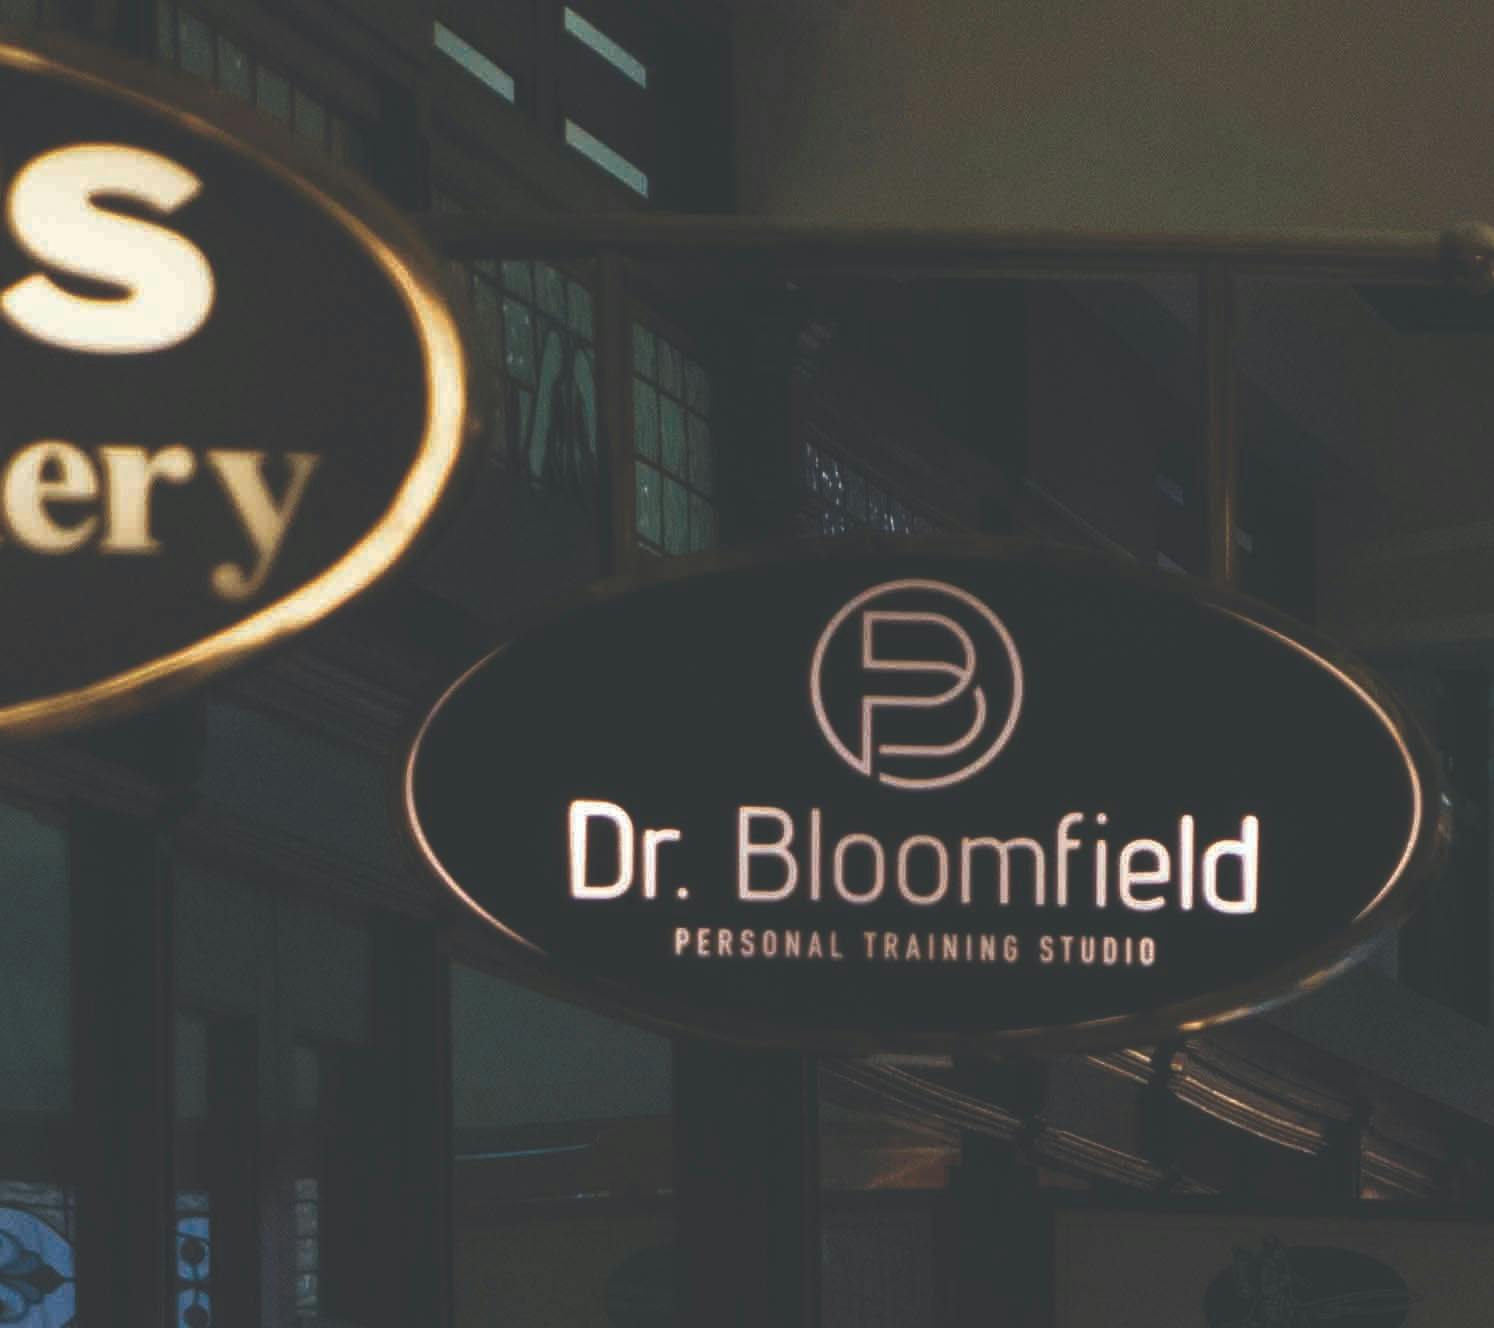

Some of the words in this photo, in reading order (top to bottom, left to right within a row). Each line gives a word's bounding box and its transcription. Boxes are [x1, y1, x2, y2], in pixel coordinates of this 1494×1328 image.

[567, 799, 690, 900] Dr.
[737, 805, 1261, 915] Bloomfield
[674, 927, 844, 958] PERSONAL
[863, 931, 1019, 963] TRAINING
[1038, 936, 1157, 967] STUDIO
